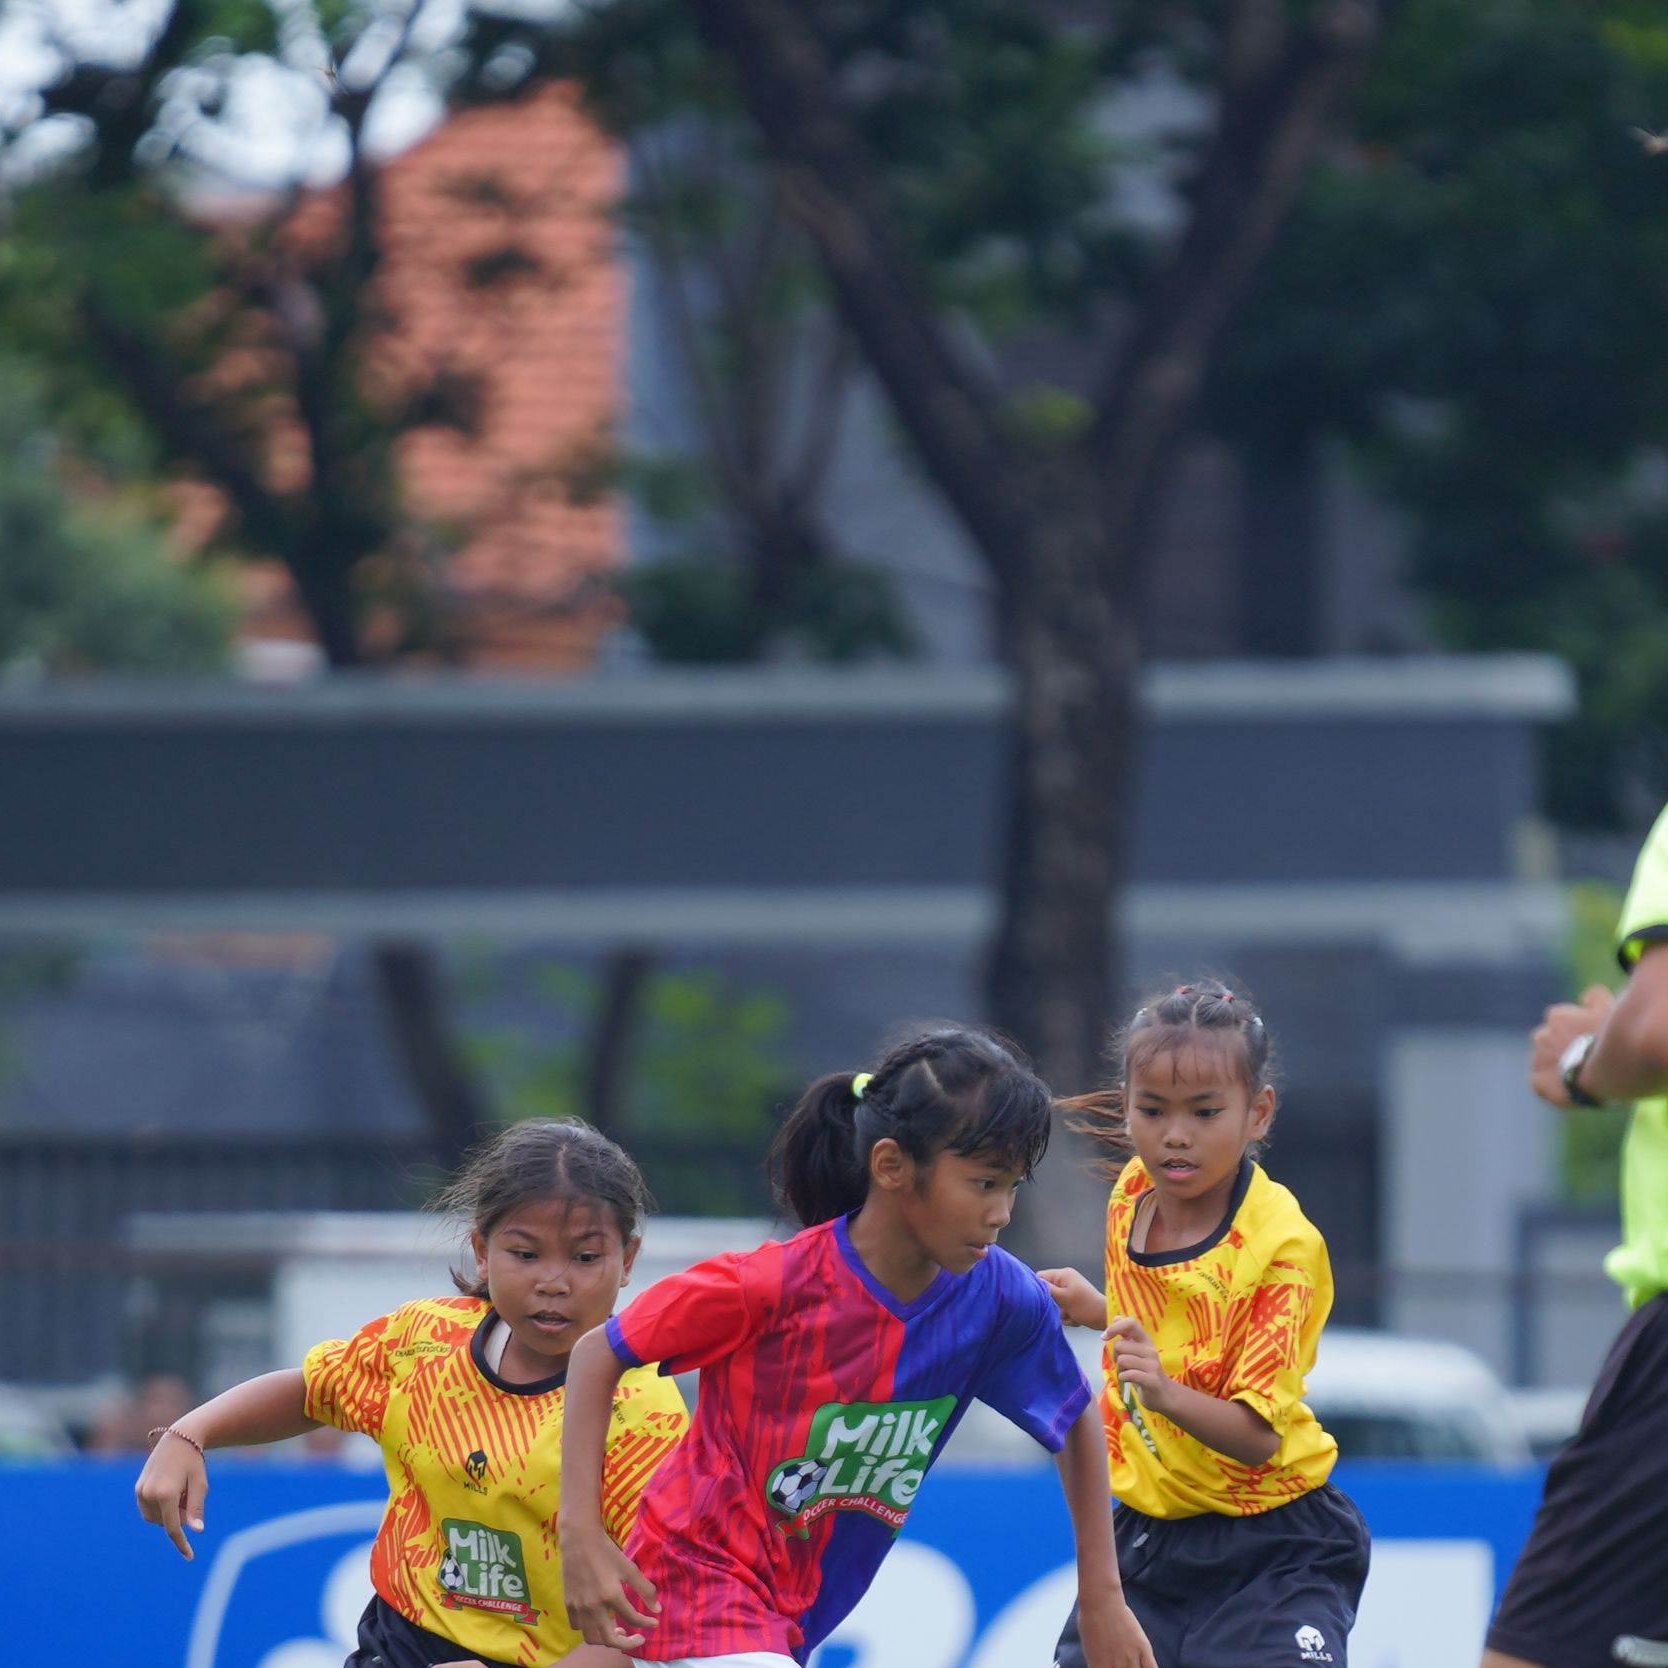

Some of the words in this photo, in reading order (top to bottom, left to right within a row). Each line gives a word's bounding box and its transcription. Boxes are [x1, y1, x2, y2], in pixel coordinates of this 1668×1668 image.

[819, 1409, 939, 1459] Milk
[463, 1481, 488, 1496] MILLS
[819, 1455, 925, 1506] Life
[802, 1497, 836, 1521] OCCER
[839, 1497, 909, 1524] CHALLENGE
[449, 1527, 517, 1569] Milk
[461, 1562, 525, 1599] Life
[476, 1599, 523, 1612] CHALLENGE
